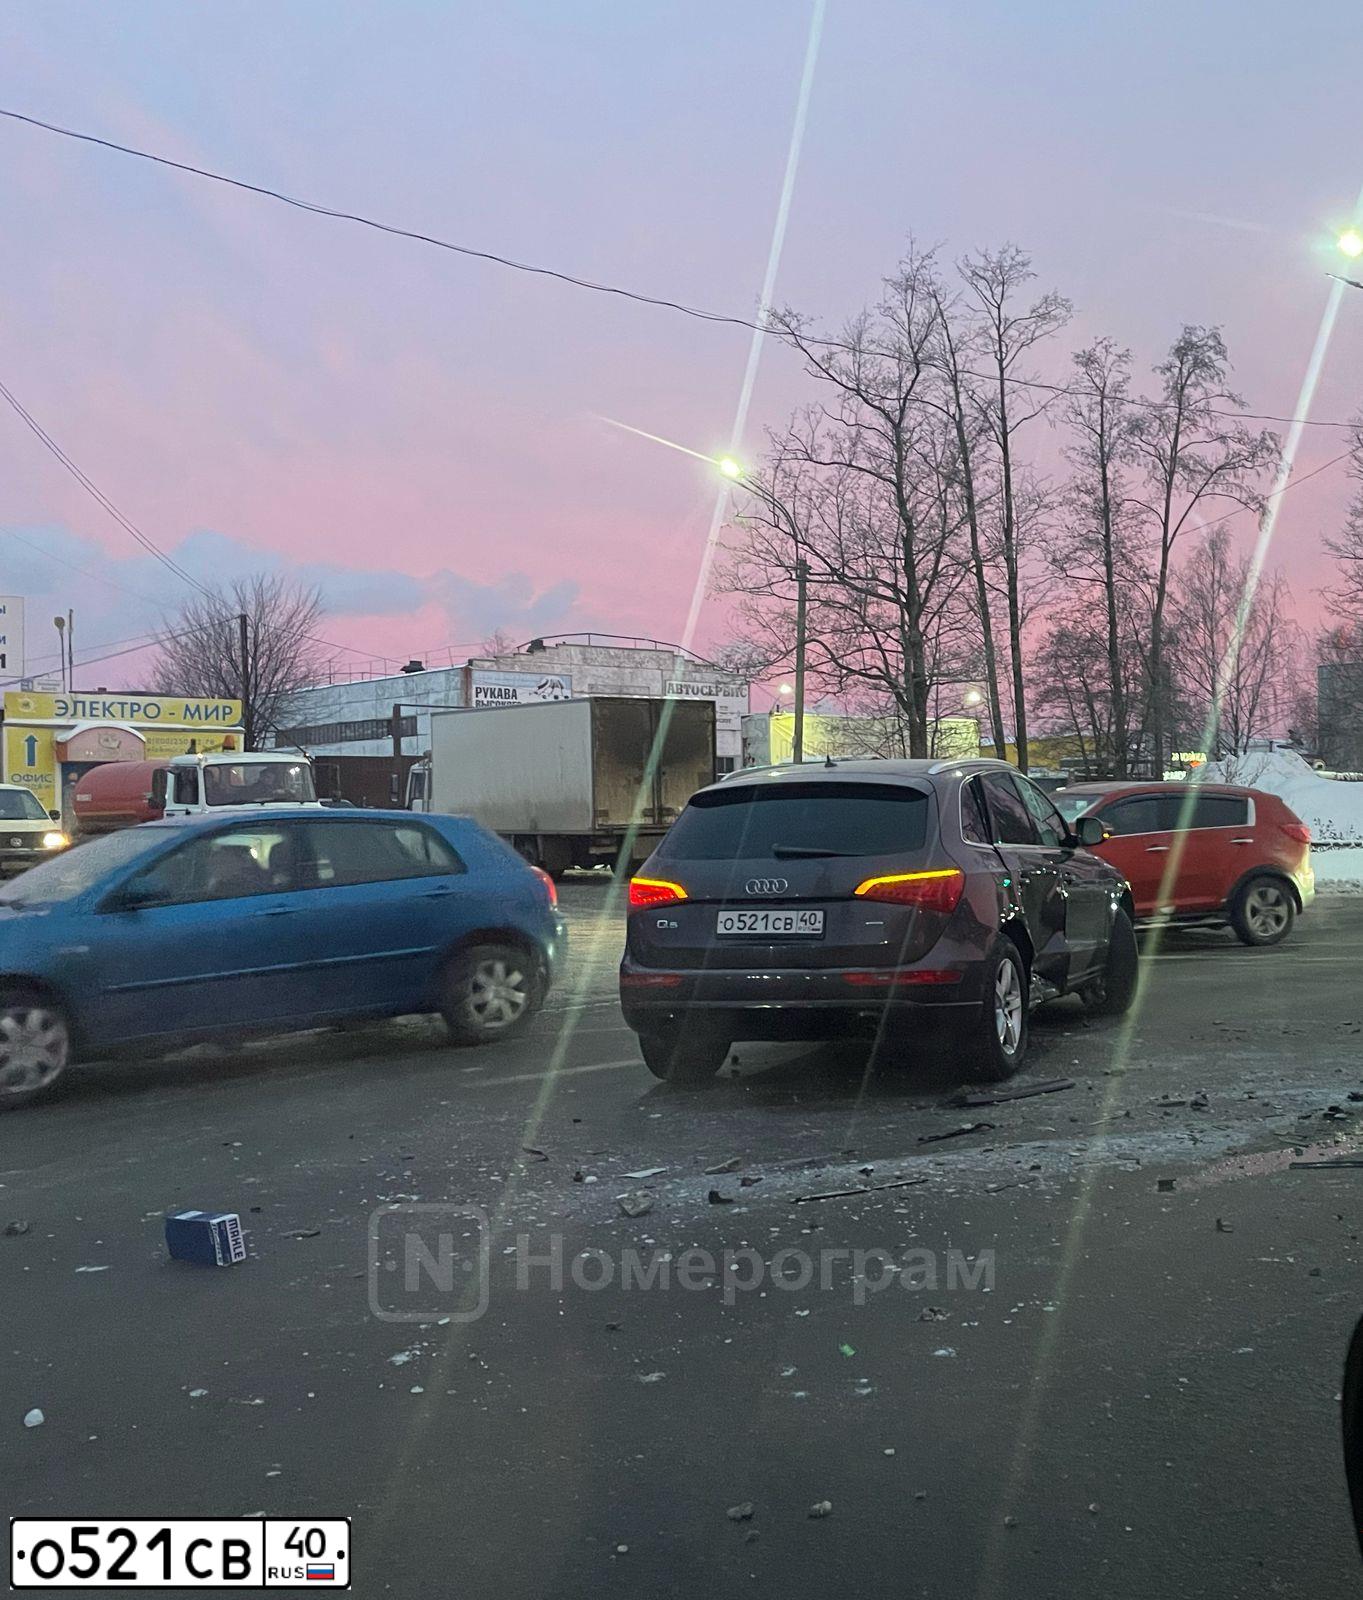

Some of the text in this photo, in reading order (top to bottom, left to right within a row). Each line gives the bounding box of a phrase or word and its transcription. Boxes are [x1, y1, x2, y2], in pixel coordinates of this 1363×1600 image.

[475, 686, 518, 700] РУКАВА
[667, 683, 748, 698] АВТОСЕРВИС
[54, 700, 161, 719] ЭЛЕКТРО
[183, 704, 233, 721] МИР
[11, 773, 53, 783] ОФИС
[656, 919, 678, 929] Q5
[723, 912, 817, 931] О521СВ 40
[228, 1218, 244, 1259] MAHLE
